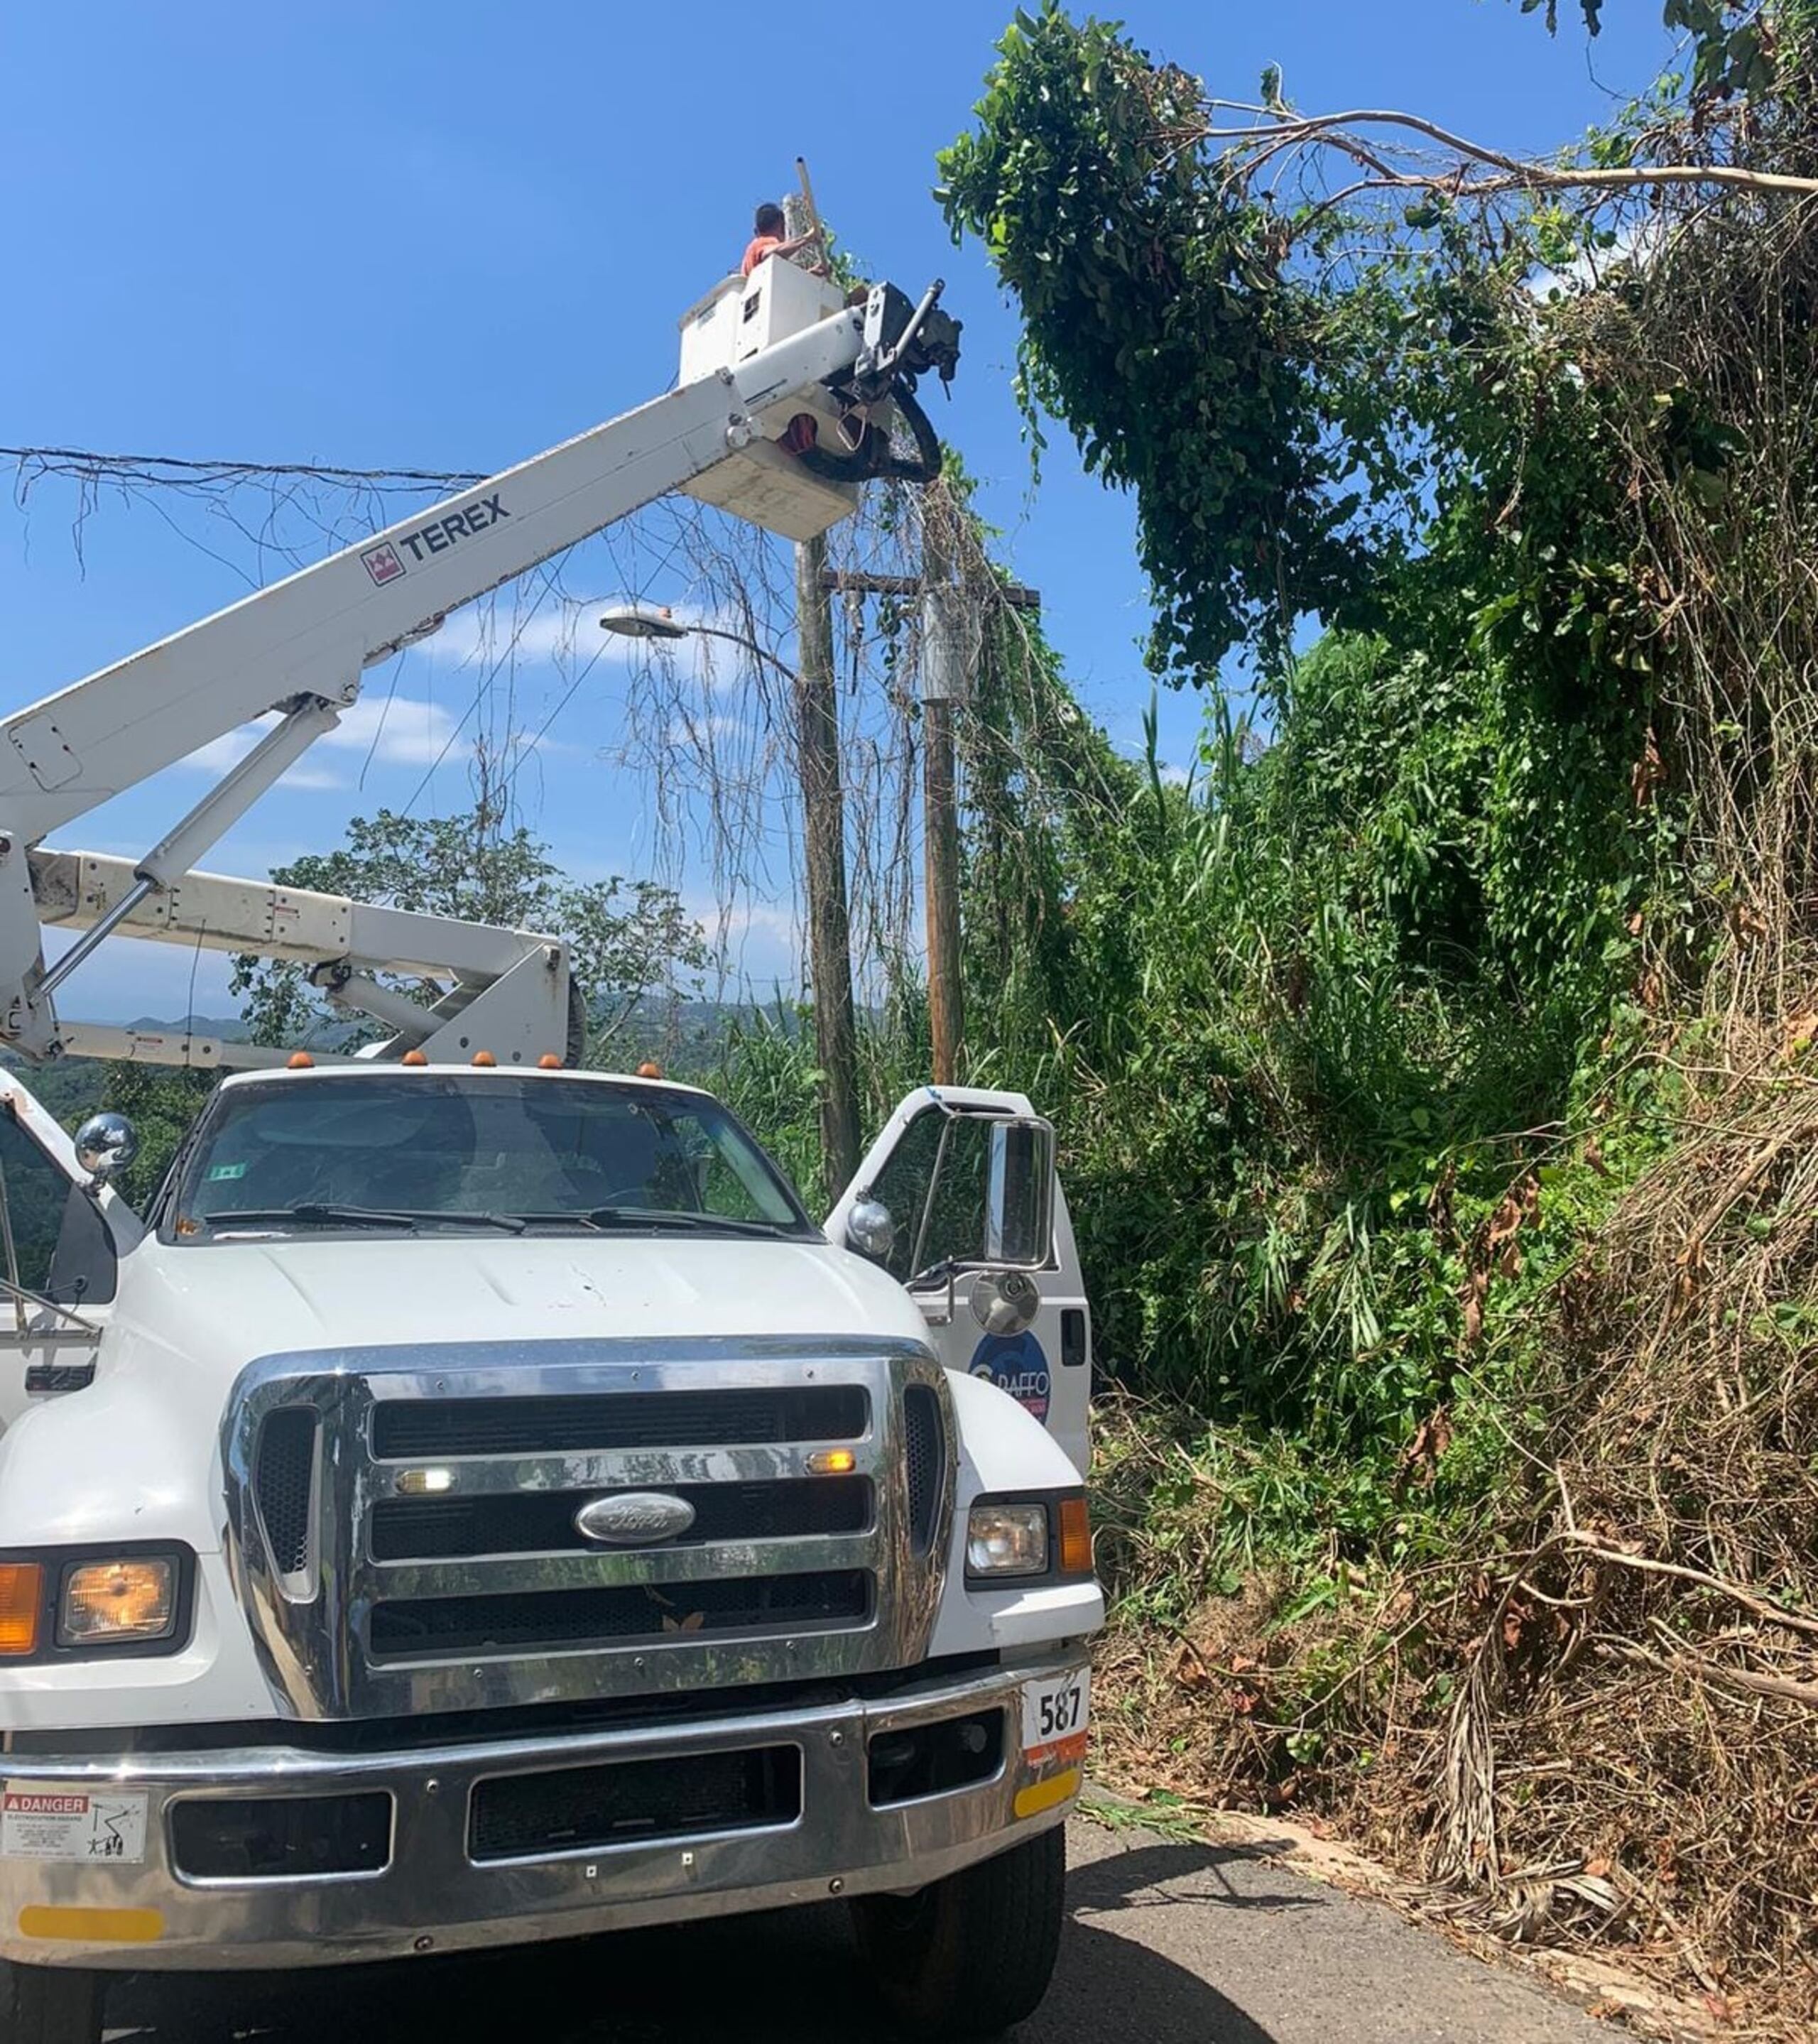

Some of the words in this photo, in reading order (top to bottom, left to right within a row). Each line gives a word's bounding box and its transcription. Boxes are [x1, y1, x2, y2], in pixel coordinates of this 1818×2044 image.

[400, 494, 511, 561] TEREX
[1040, 1686, 1081, 1736] 587
[21, 1797, 84, 1812] DANGER
